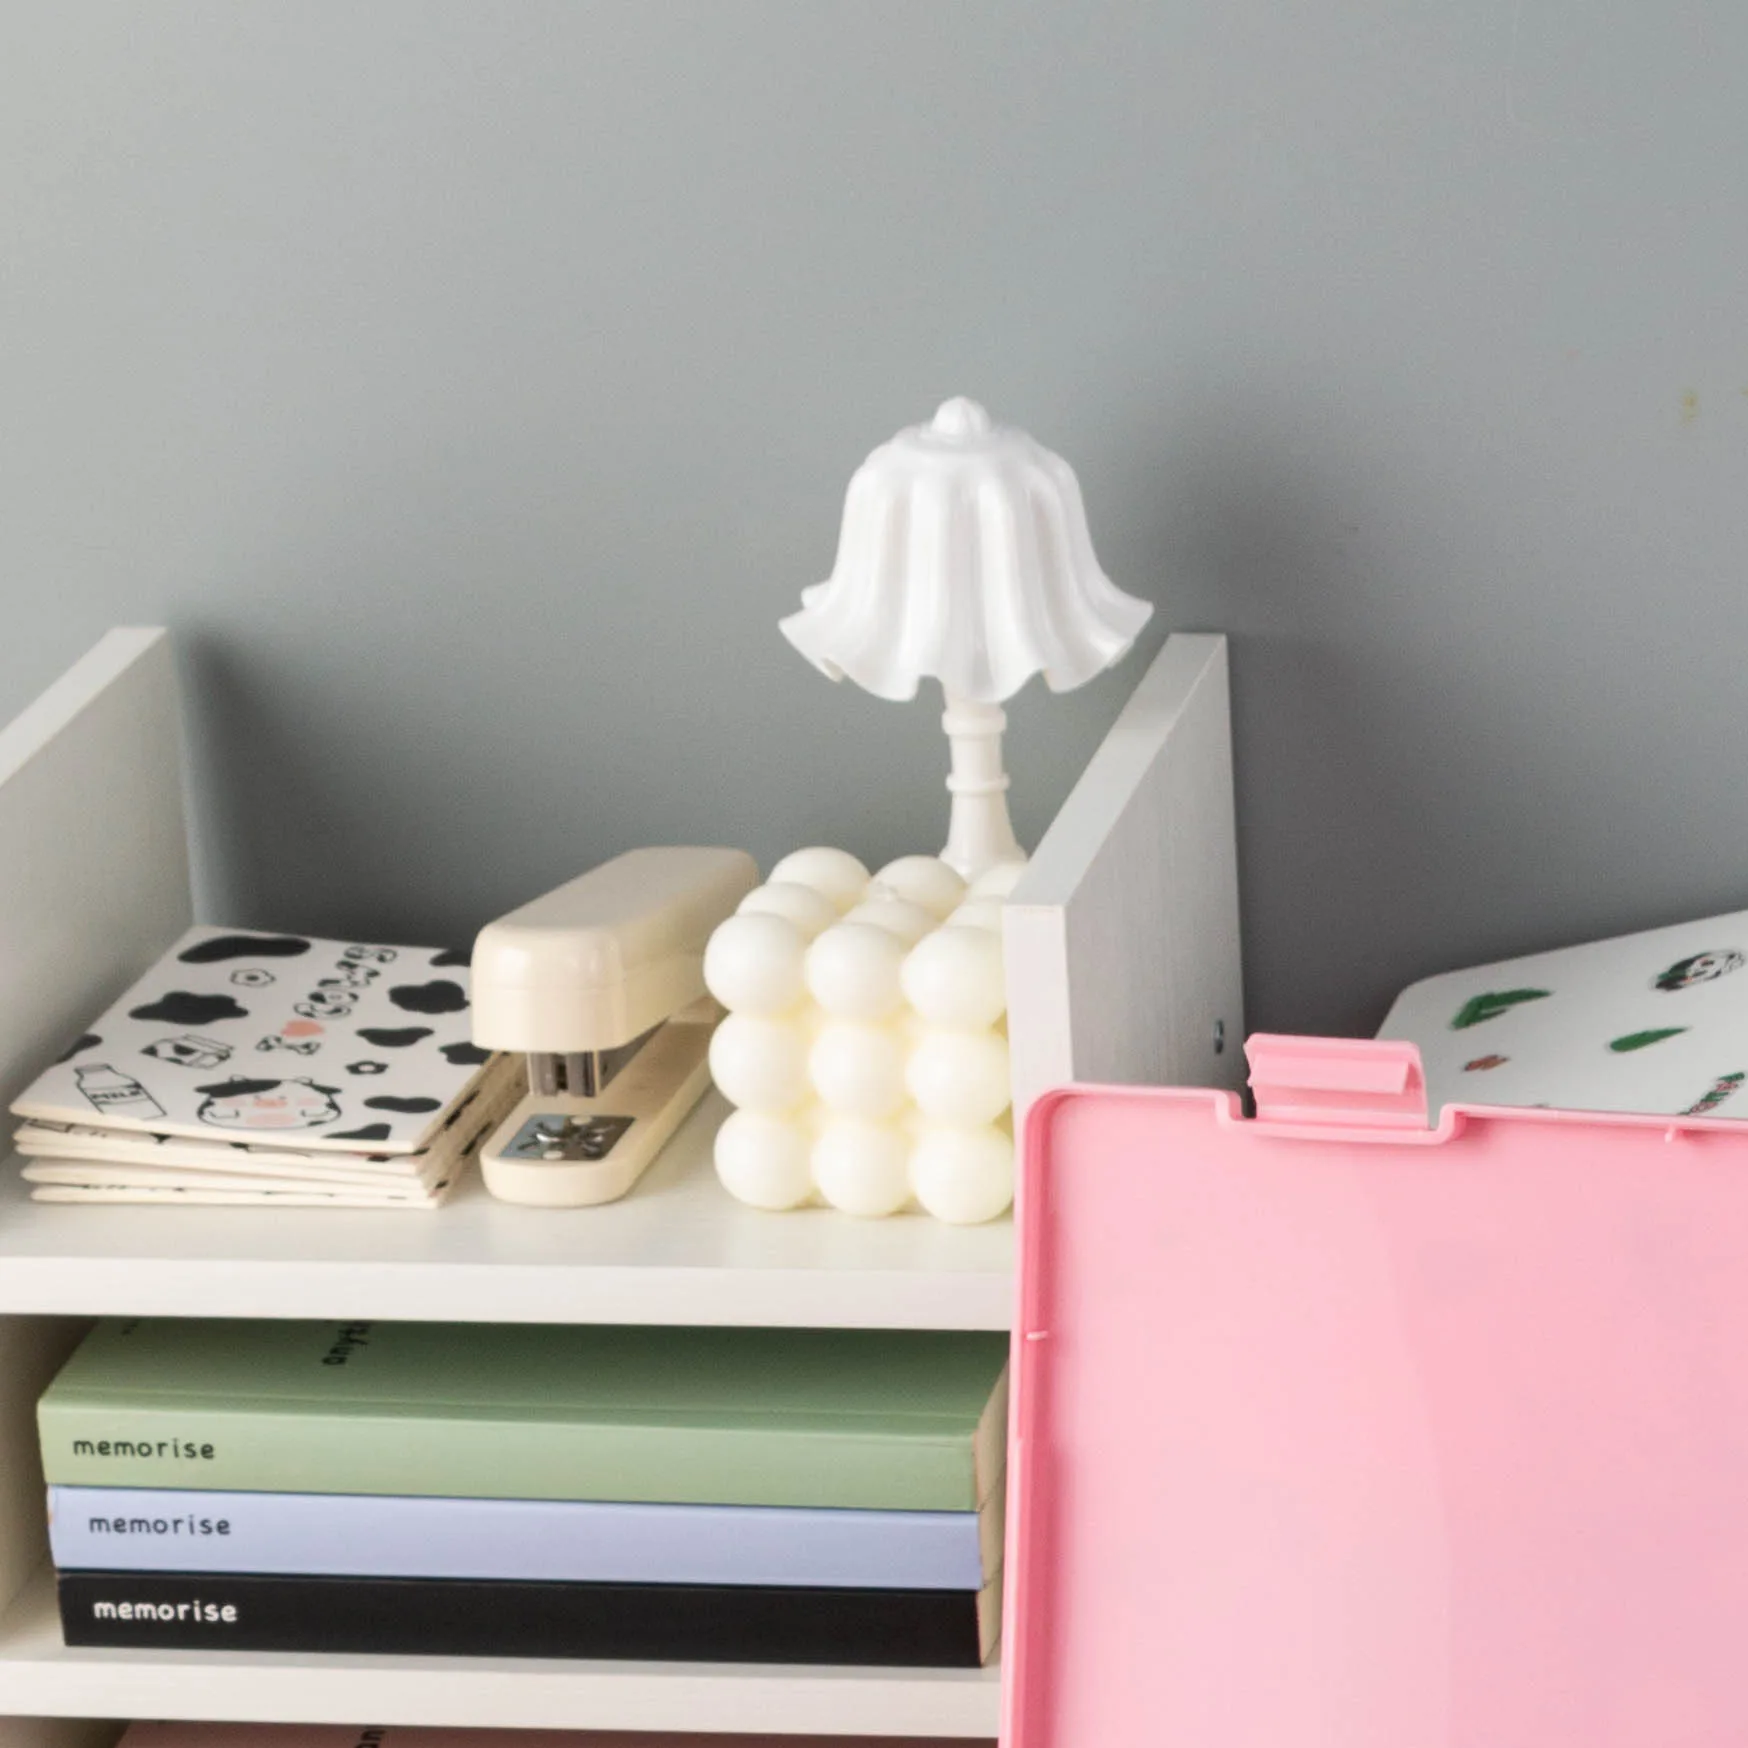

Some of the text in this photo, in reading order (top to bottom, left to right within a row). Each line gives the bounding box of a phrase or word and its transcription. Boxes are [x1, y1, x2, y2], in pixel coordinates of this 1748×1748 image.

[73, 1438, 215, 1460] memorise
[89, 1514, 231, 1536] memorise
[94, 1599, 238, 1623] memorise
